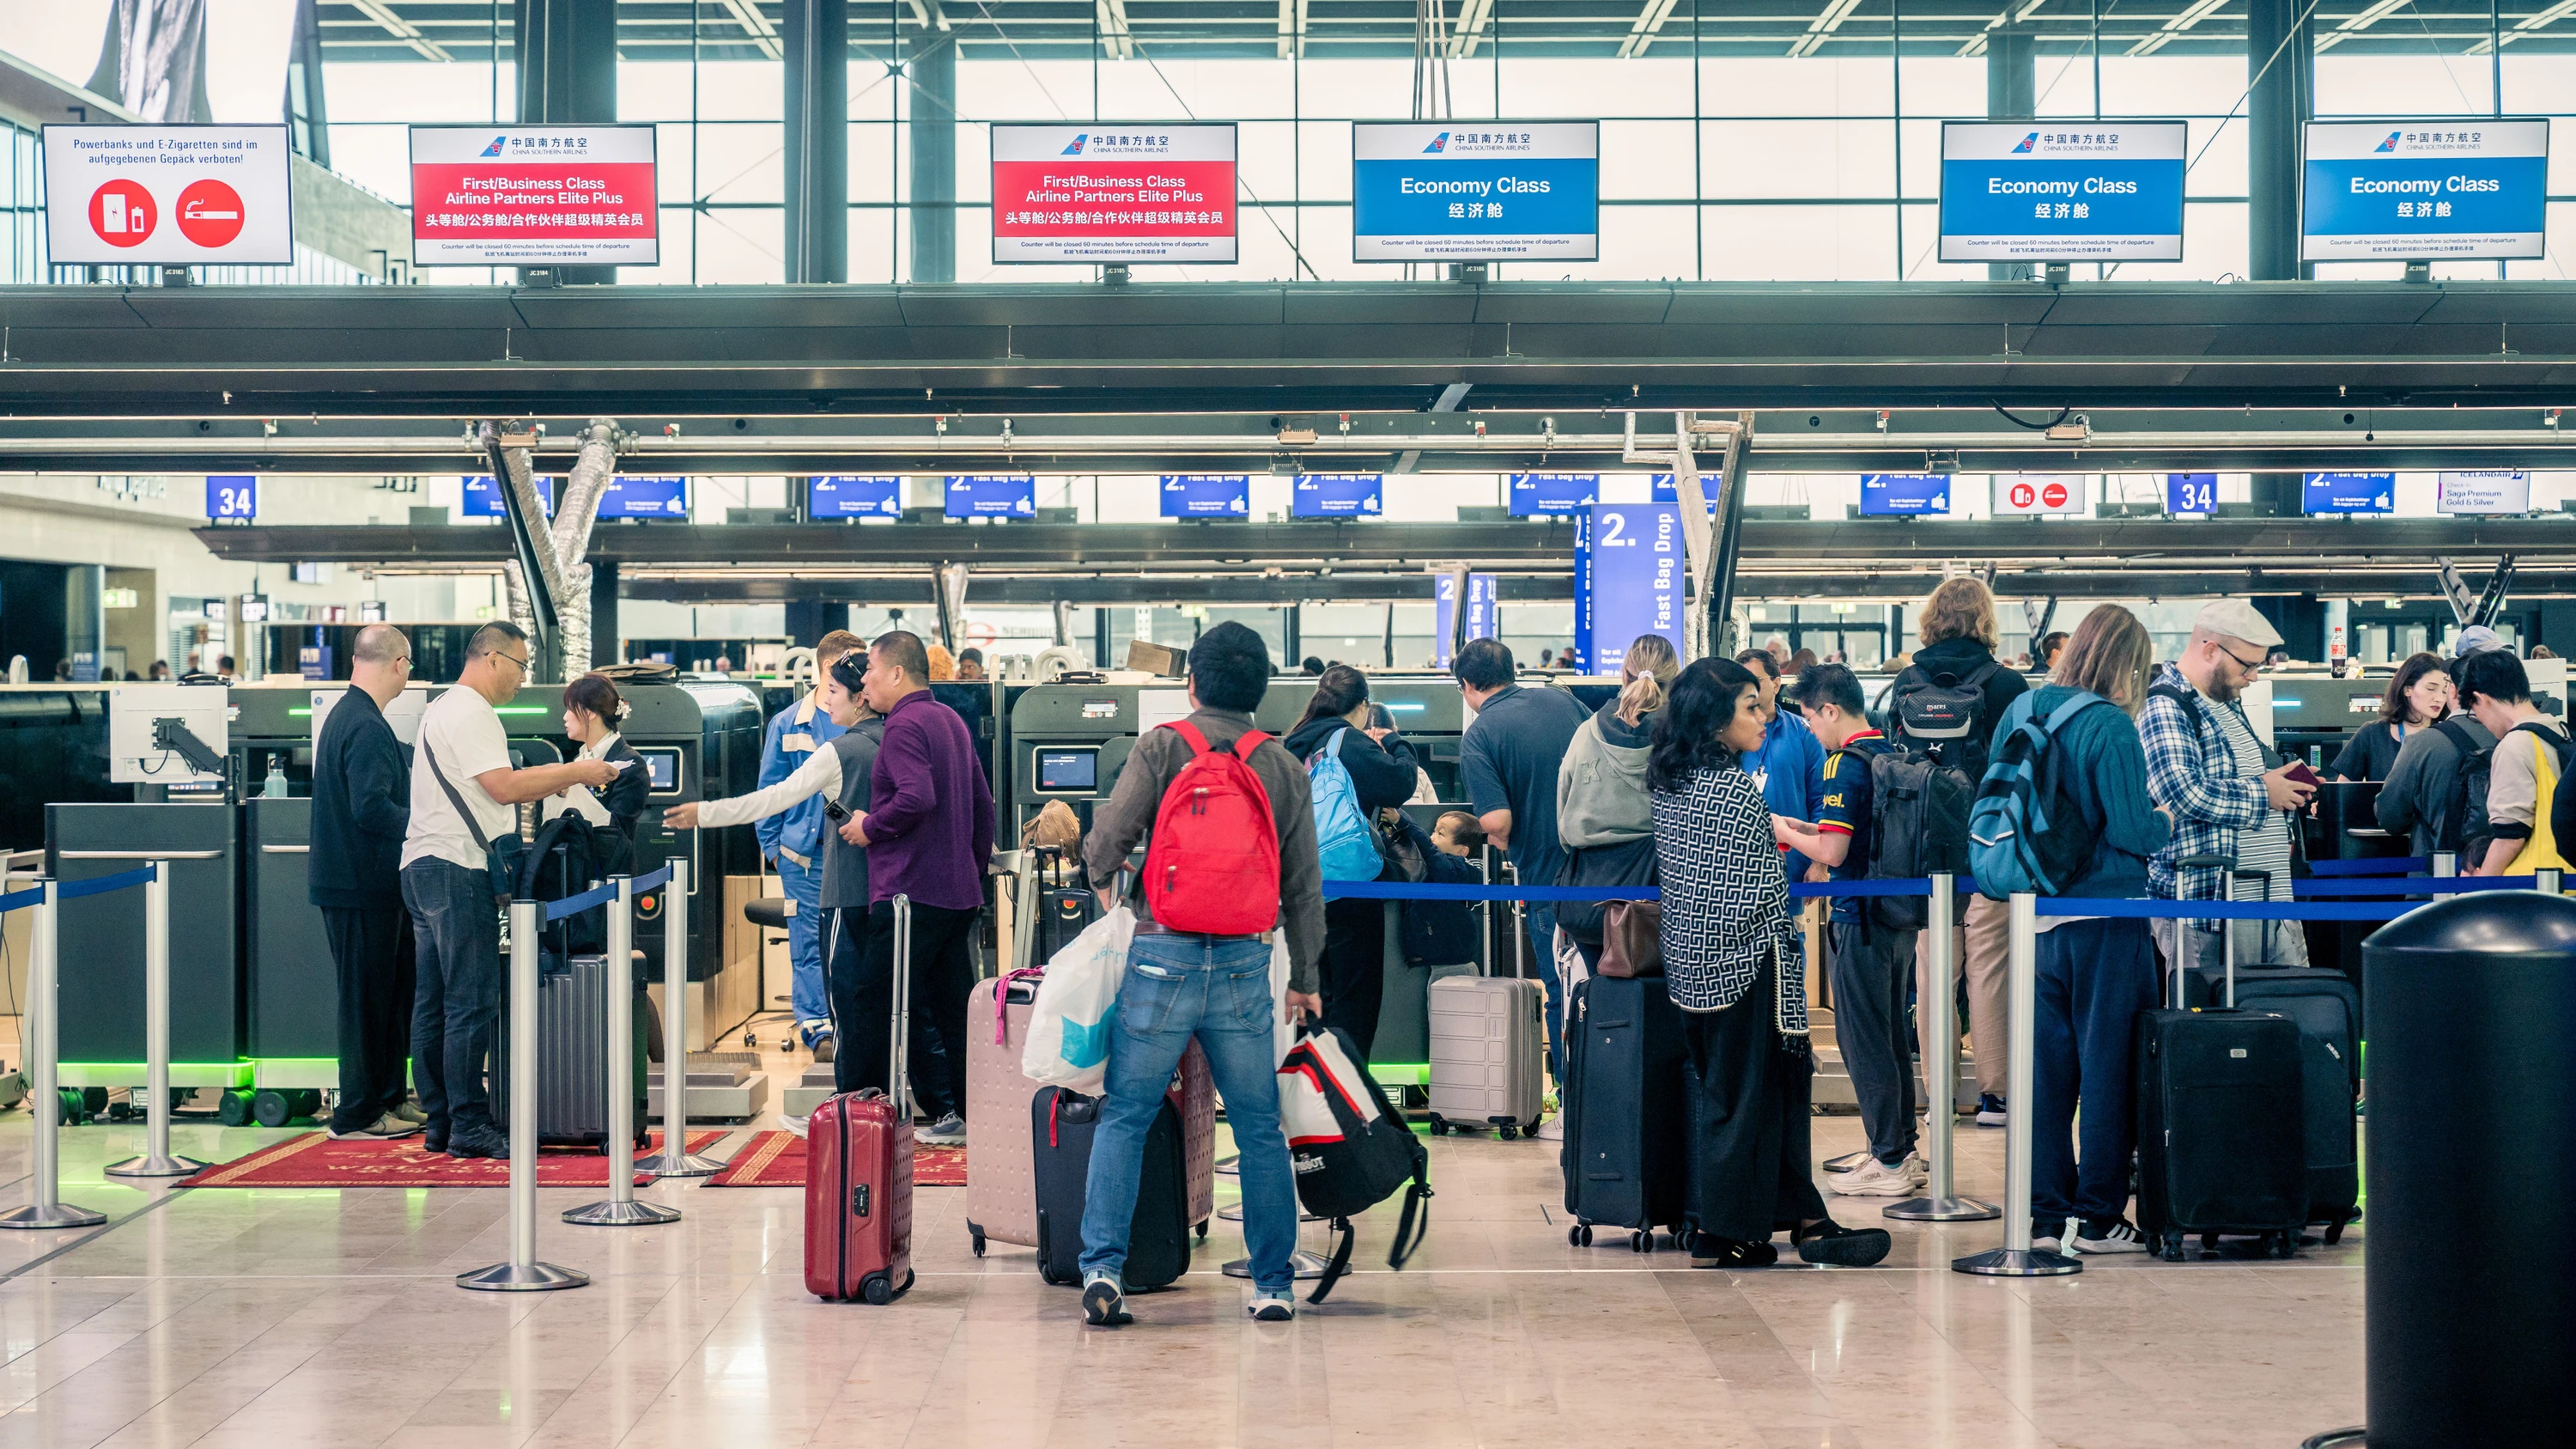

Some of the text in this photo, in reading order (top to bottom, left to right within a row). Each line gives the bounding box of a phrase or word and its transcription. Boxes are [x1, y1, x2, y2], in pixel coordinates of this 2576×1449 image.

[513, 137, 586, 148] 中国南方航空
[1094, 136, 1168, 145] 中国南方航空
[1455, 133, 1529, 143] 中国南方航空
[2044, 134, 2118, 143] 中国南方航空
[2407, 132, 2481, 143] 中国南方航空
[75, 139, 257, 151] Powerbanks und E-Zigaretten sind im
[89, 154, 242, 165] aufgegebenen Gepäck verboten!
[463, 177, 605, 190] First/Business Class
[1044, 174, 1185, 187] First/Business Class
[1401, 177, 1550, 197] Economy Class
[1989, 177, 2136, 197] Economy Class
[2351, 175, 2499, 196] Economy Class
[446, 192, 623, 204] Airline Partners Elite Plus
[1026, 190, 1203, 203] Airline Partners Elite Plus
[1449, 203, 1503, 218] 经济舱
[2035, 203, 2089, 219] 经济舱
[2397, 202, 2451, 217] 经济舱
[426, 213, 644, 227] 头等舱/公务舱/合作伙伴超级精英会员
[1005, 211, 1224, 225] 头等舱/公务舱/合作伙伴超级精英会员
[1516, 474, 1535, 489] 2.
[2182, 484, 2213, 511] 34
[2447, 490, 2466, 498] Saga
[220, 487, 252, 515] 34
[1601, 513, 1636, 547] 2.
[1654, 513, 1674, 630] Fast Bag Drop
[1861, 1172, 1881, 1181] HOKA
